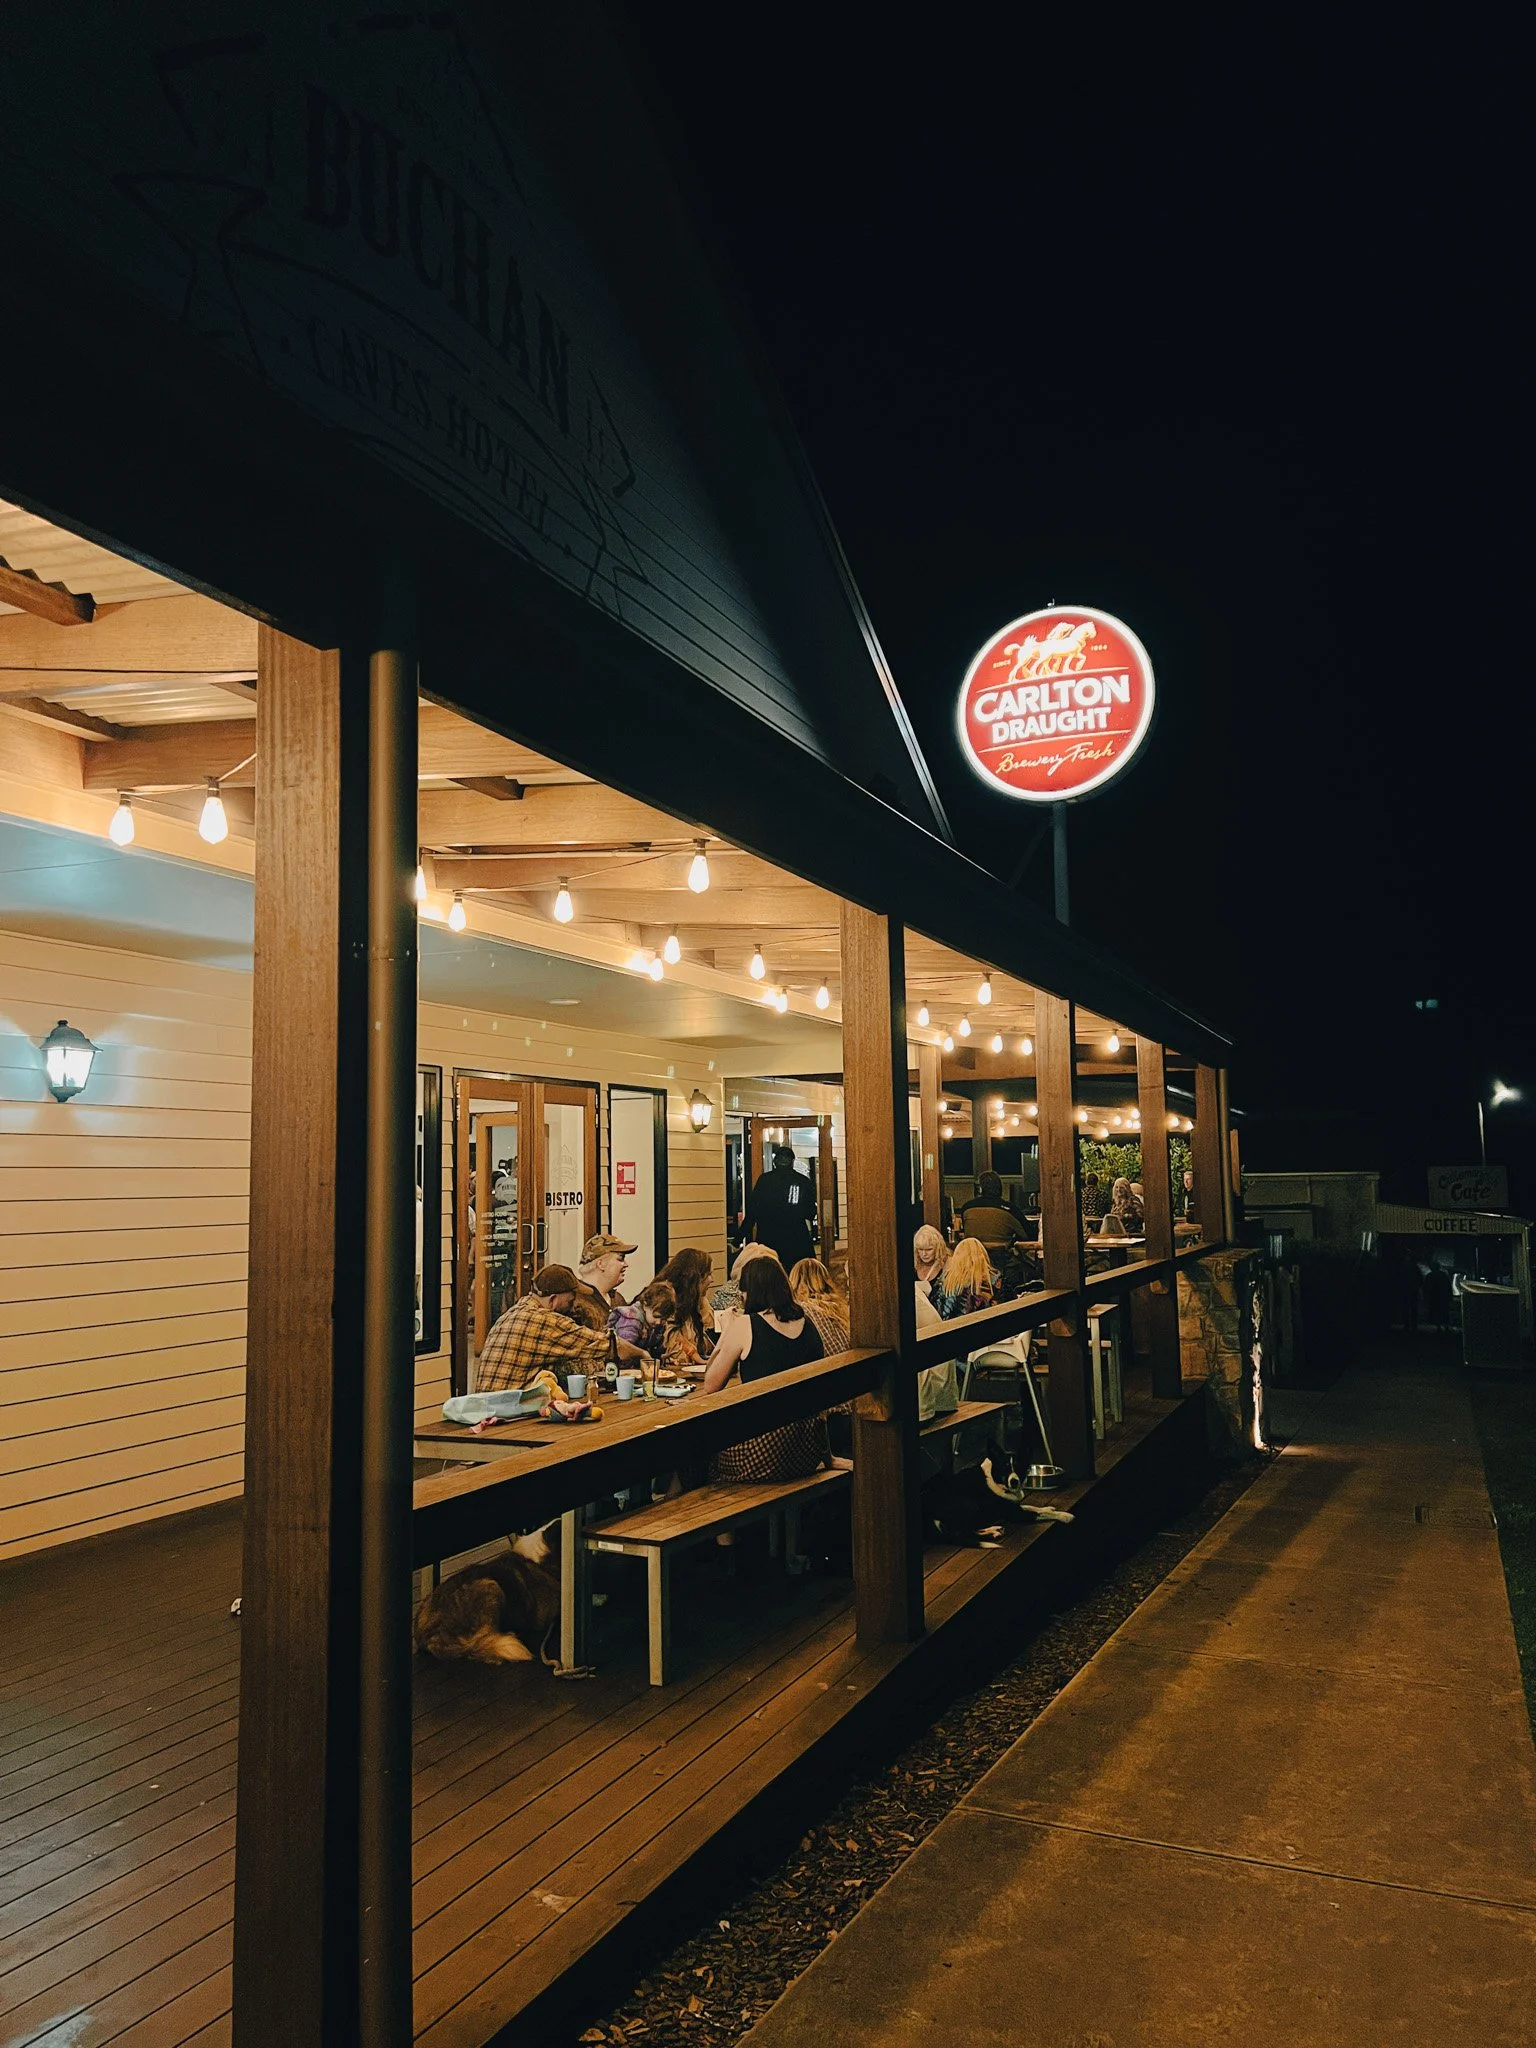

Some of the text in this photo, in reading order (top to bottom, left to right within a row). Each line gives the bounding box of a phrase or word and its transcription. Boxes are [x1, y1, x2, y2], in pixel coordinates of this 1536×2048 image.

[301, 80, 571, 436] BUCHAN
[307, 316, 551, 544] CAVES HOTEL
[973, 675, 1130, 722] CARLTON
[991, 707, 1112, 744] DRAUGHT
[995, 740, 1115, 776] Brewery Fresh
[545, 1191, 583, 1206] BISTRO
[1424, 1218, 1478, 1232] COFFEE
